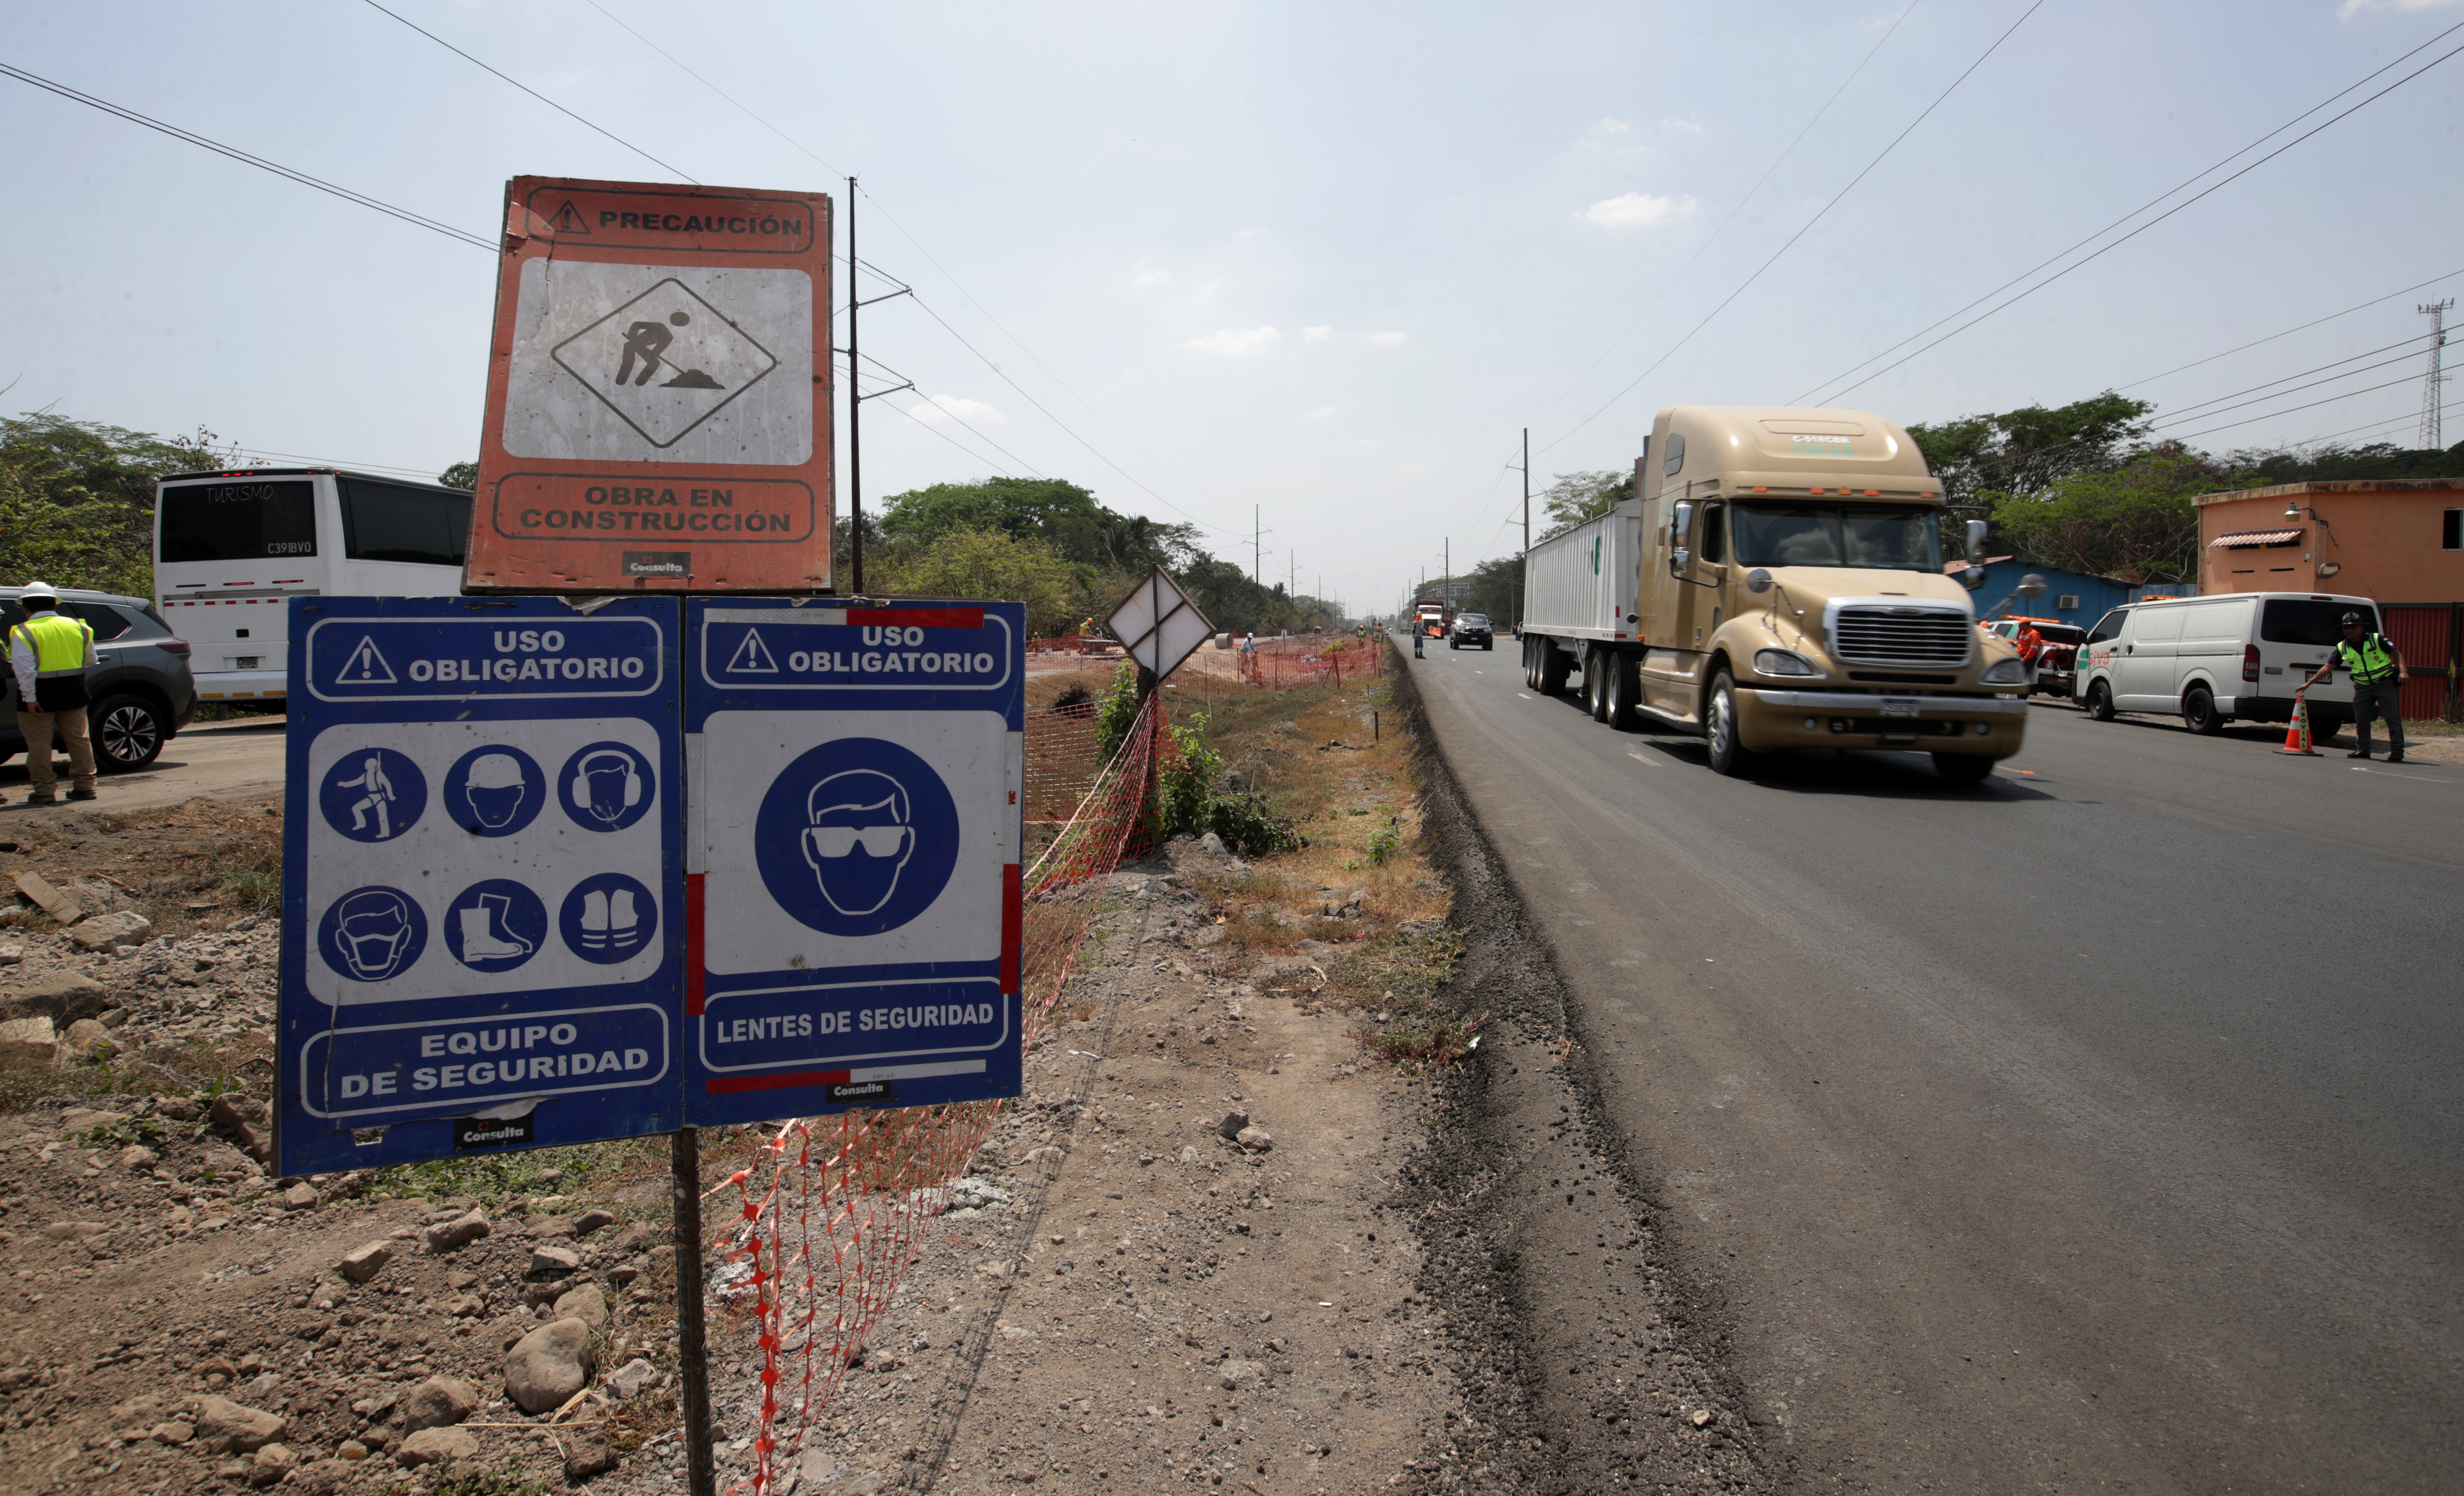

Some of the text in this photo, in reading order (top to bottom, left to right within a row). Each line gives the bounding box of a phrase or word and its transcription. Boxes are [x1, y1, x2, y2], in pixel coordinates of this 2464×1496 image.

[599, 210, 802, 236] PRECAUCIÓN
[206, 485, 273, 503] TURISMO
[585, 486, 733, 507] OBRA EN
[519, 509, 791, 532] CONSTRUCCIÓN
[268, 542, 311, 554] C391BVQ
[630, 562, 683, 571] Consulta
[494, 630, 565, 653] USO
[862, 626, 924, 646] USO
[788, 651, 994, 673] OBLIGATORIO
[2088, 650, 2110, 667] siva
[408, 657, 644, 682] OBLIGATORIO
[1008, 790, 1016, 805] 3M
[718, 1003, 993, 1043] LENTES DE SEGURIDAD
[421, 1023, 577, 1057] EQUIPO
[341, 1048, 648, 1099] DE SEGURIDAD
[834, 1083, 883, 1096] Consulta
[463, 1127, 524, 1142] Consulta
